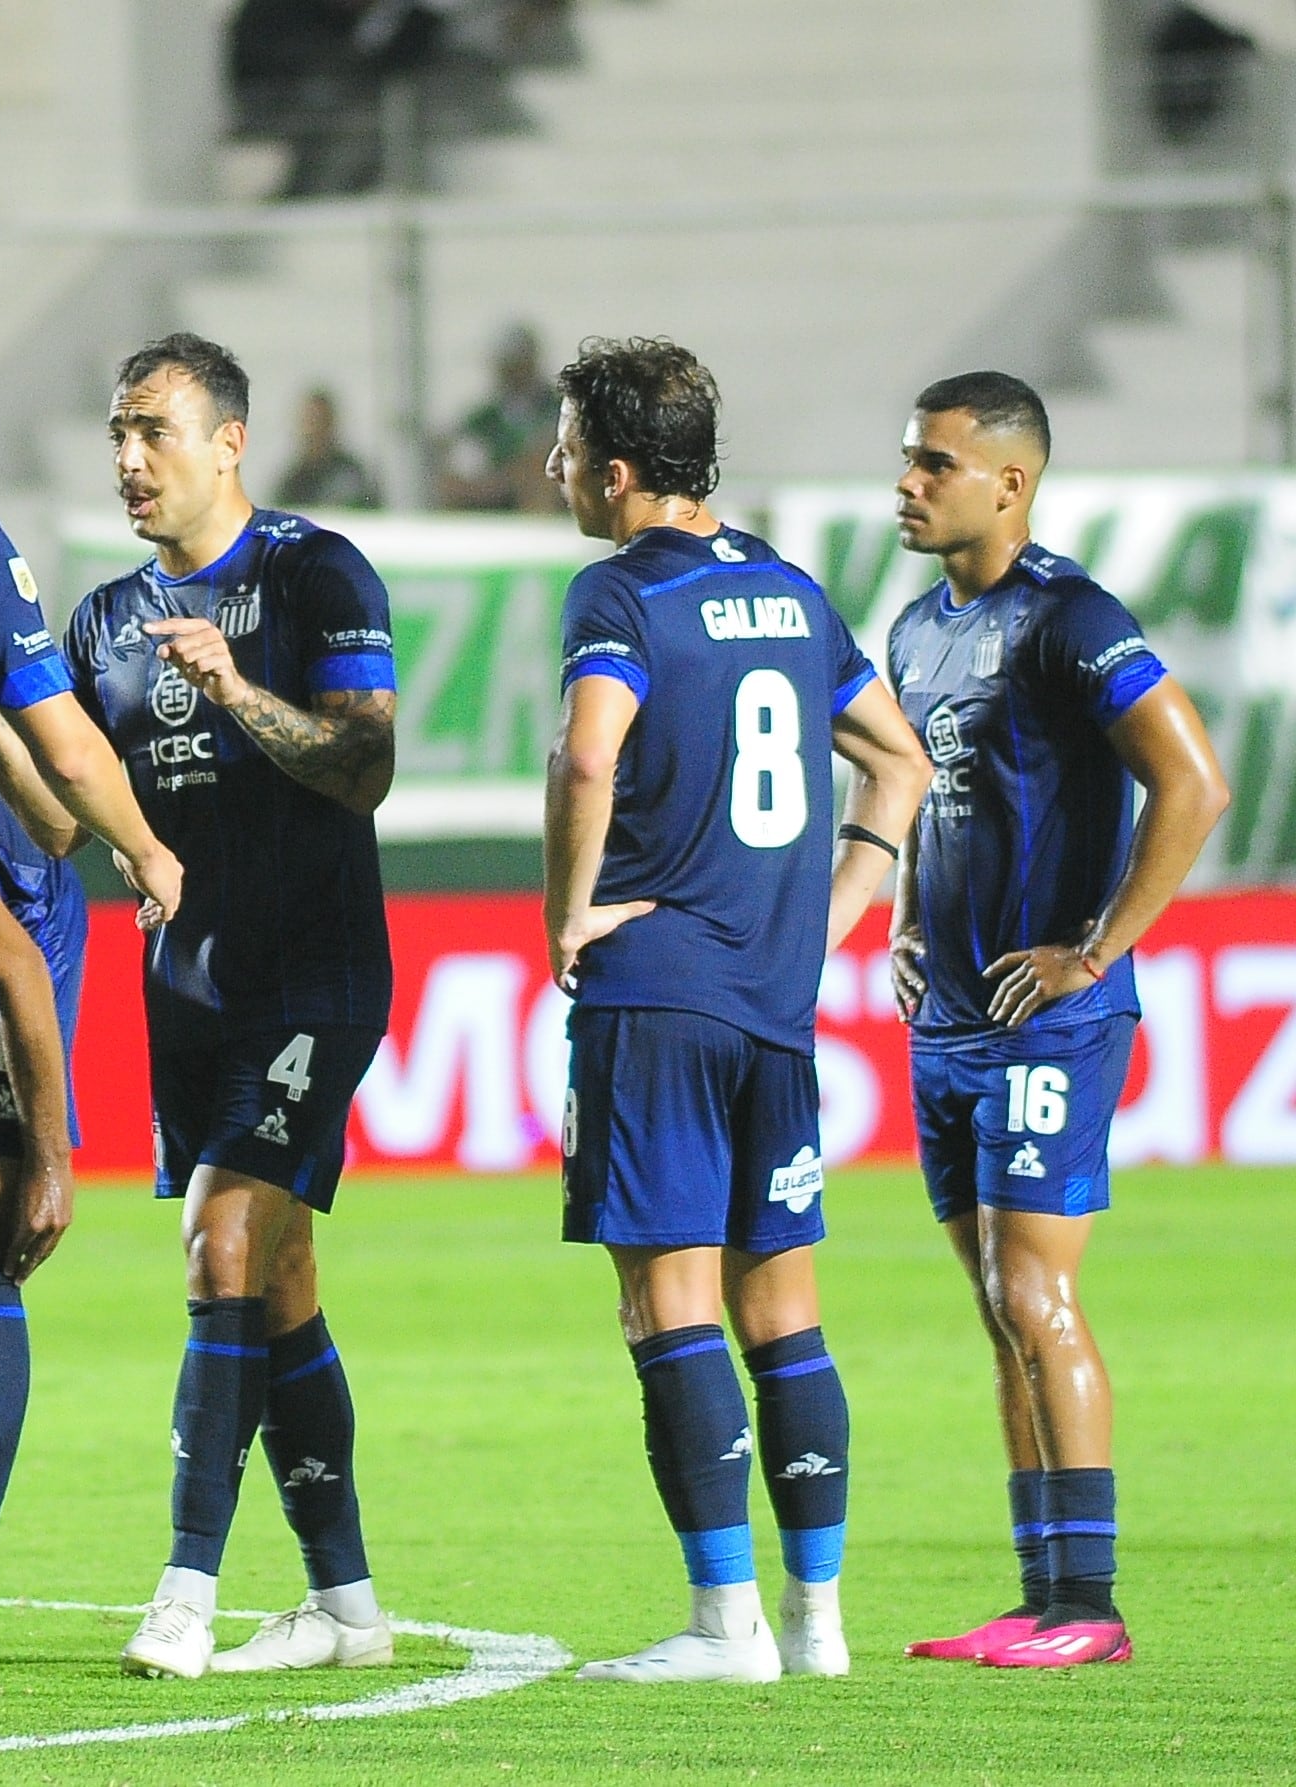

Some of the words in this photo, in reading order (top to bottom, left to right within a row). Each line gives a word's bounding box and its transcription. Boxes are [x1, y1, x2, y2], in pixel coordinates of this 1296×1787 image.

[700, 596, 812, 640] GALARZA
[150, 732, 214, 766] ICBC
[730, 669, 808, 848] 8
[267, 1033, 314, 1102] 4
[1006, 1065, 1069, 1135] 16
[562, 1087, 578, 1158] 8
